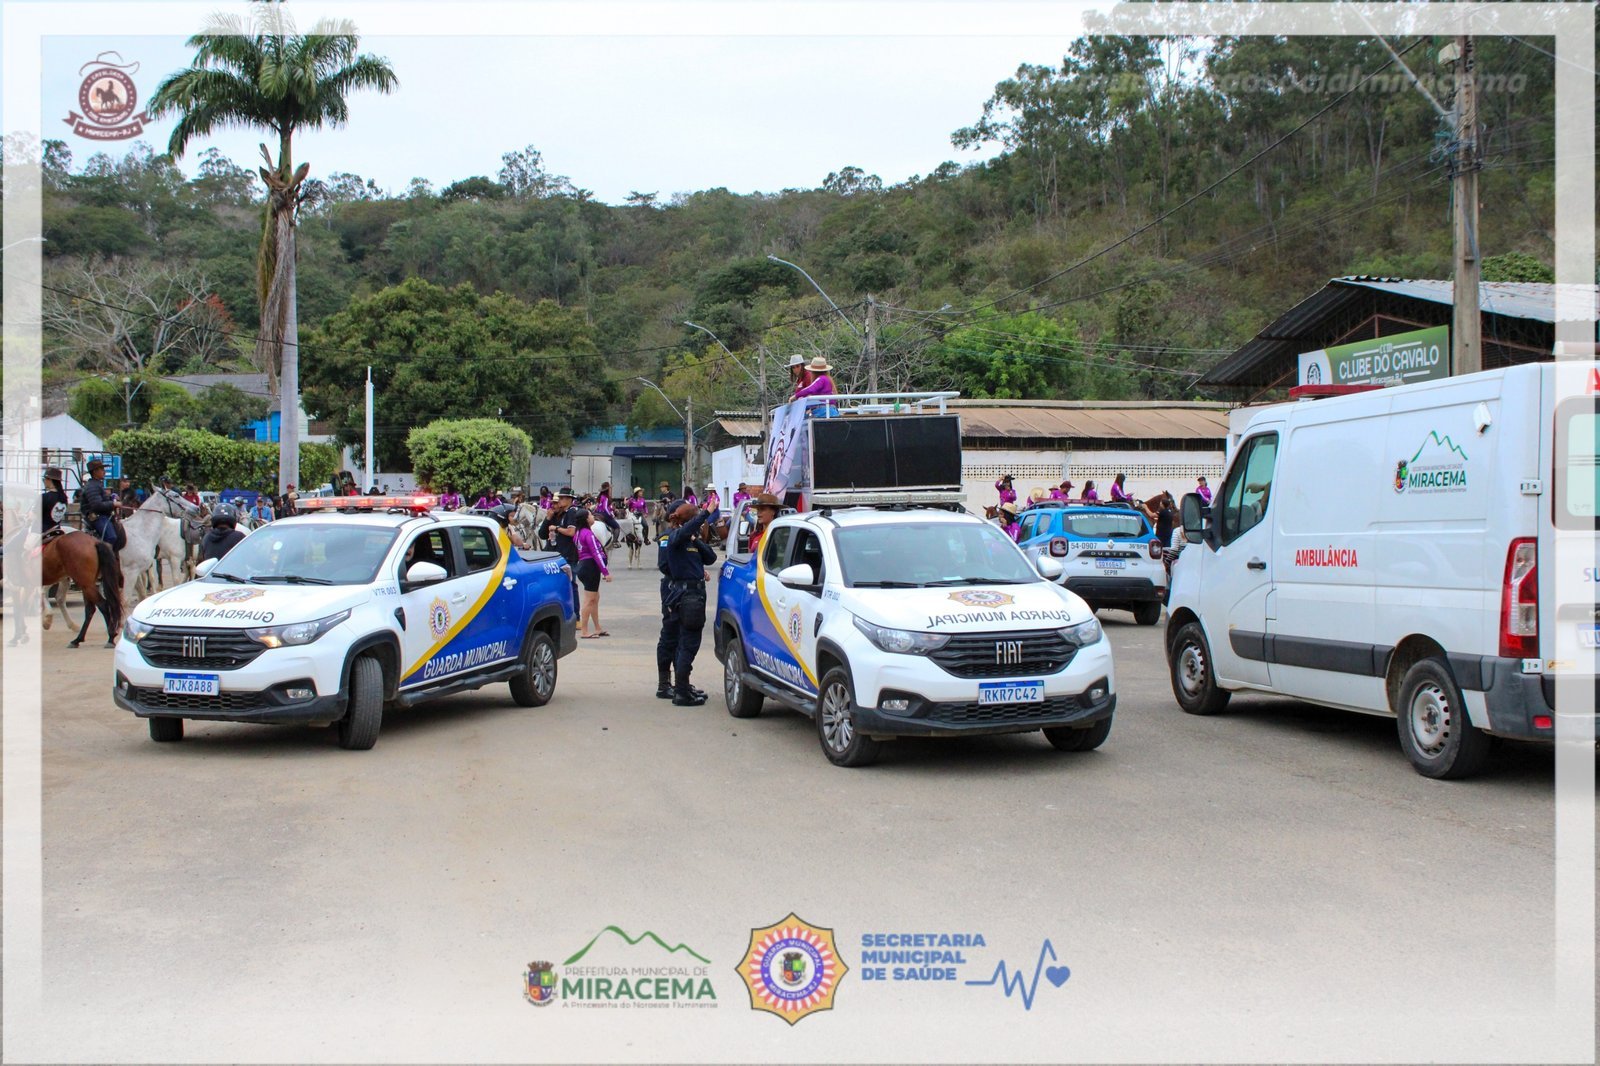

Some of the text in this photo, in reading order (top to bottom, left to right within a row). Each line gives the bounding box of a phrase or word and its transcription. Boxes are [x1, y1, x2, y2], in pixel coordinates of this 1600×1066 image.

[1339, 345, 1440, 380] CLUBE DO CAVALO
[1408, 470, 1467, 489] MIRACEMA
[1071, 542, 1098, 550] 54-0907
[1295, 544, 1358, 567] AMBULÂNCIA
[373, 586, 397, 596] VTR 003
[182, 636, 208, 658] FIAT
[994, 640, 1024, 665] FIAT
[424, 640, 507, 679] GUARDA MUNICIPAL
[752, 647, 809, 689] GUARDA MUNICIPAL
[169, 680, 213, 693] RJK8A88
[984, 687, 1038, 702] RKR7C42
